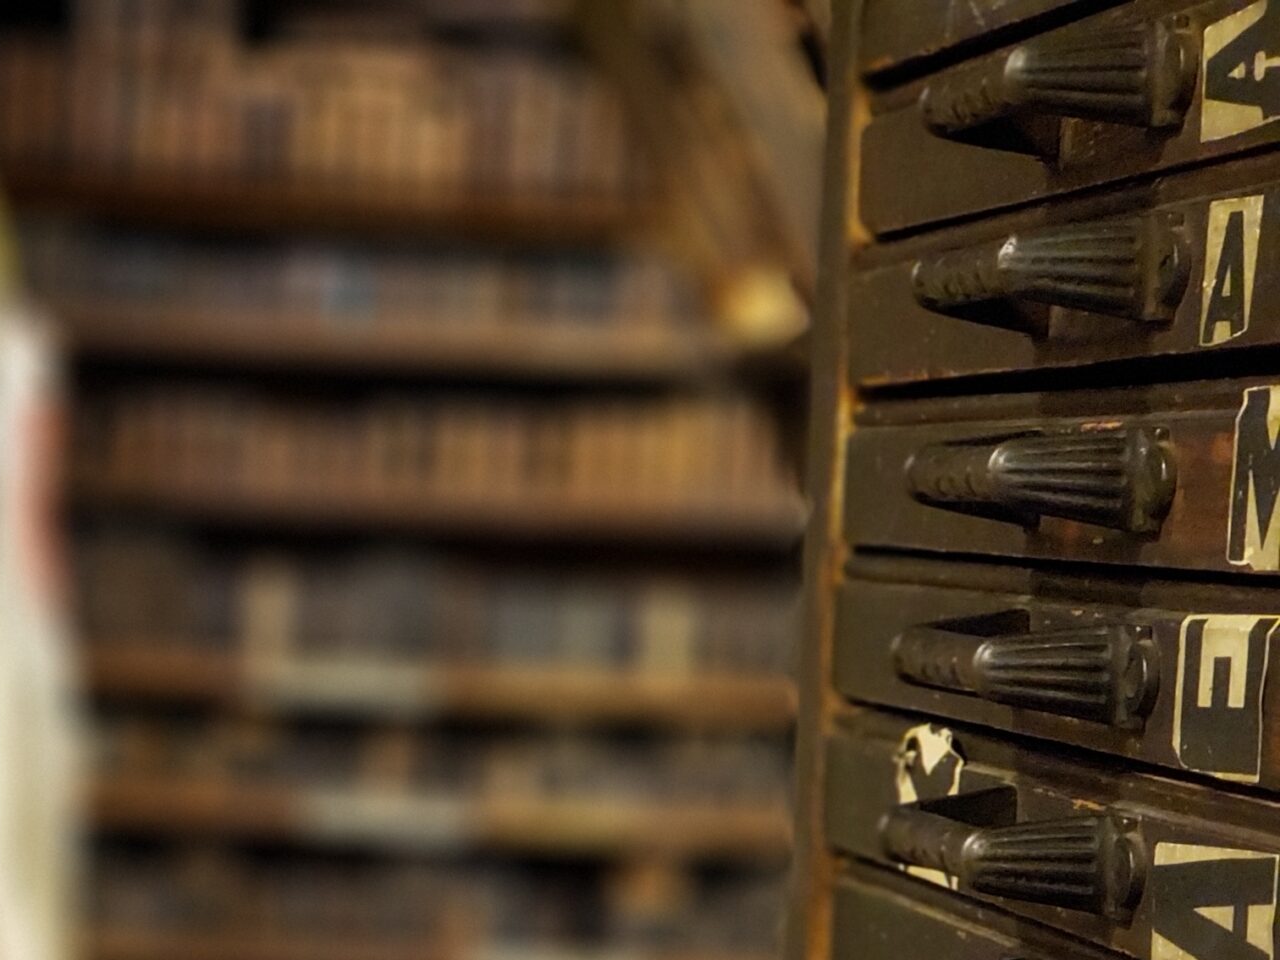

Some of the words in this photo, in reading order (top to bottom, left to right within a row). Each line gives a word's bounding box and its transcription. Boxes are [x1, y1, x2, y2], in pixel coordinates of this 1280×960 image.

[1205, 0, 1280, 122] A
[1202, 210, 1250, 345] A
[1178, 617, 1279, 776] E
